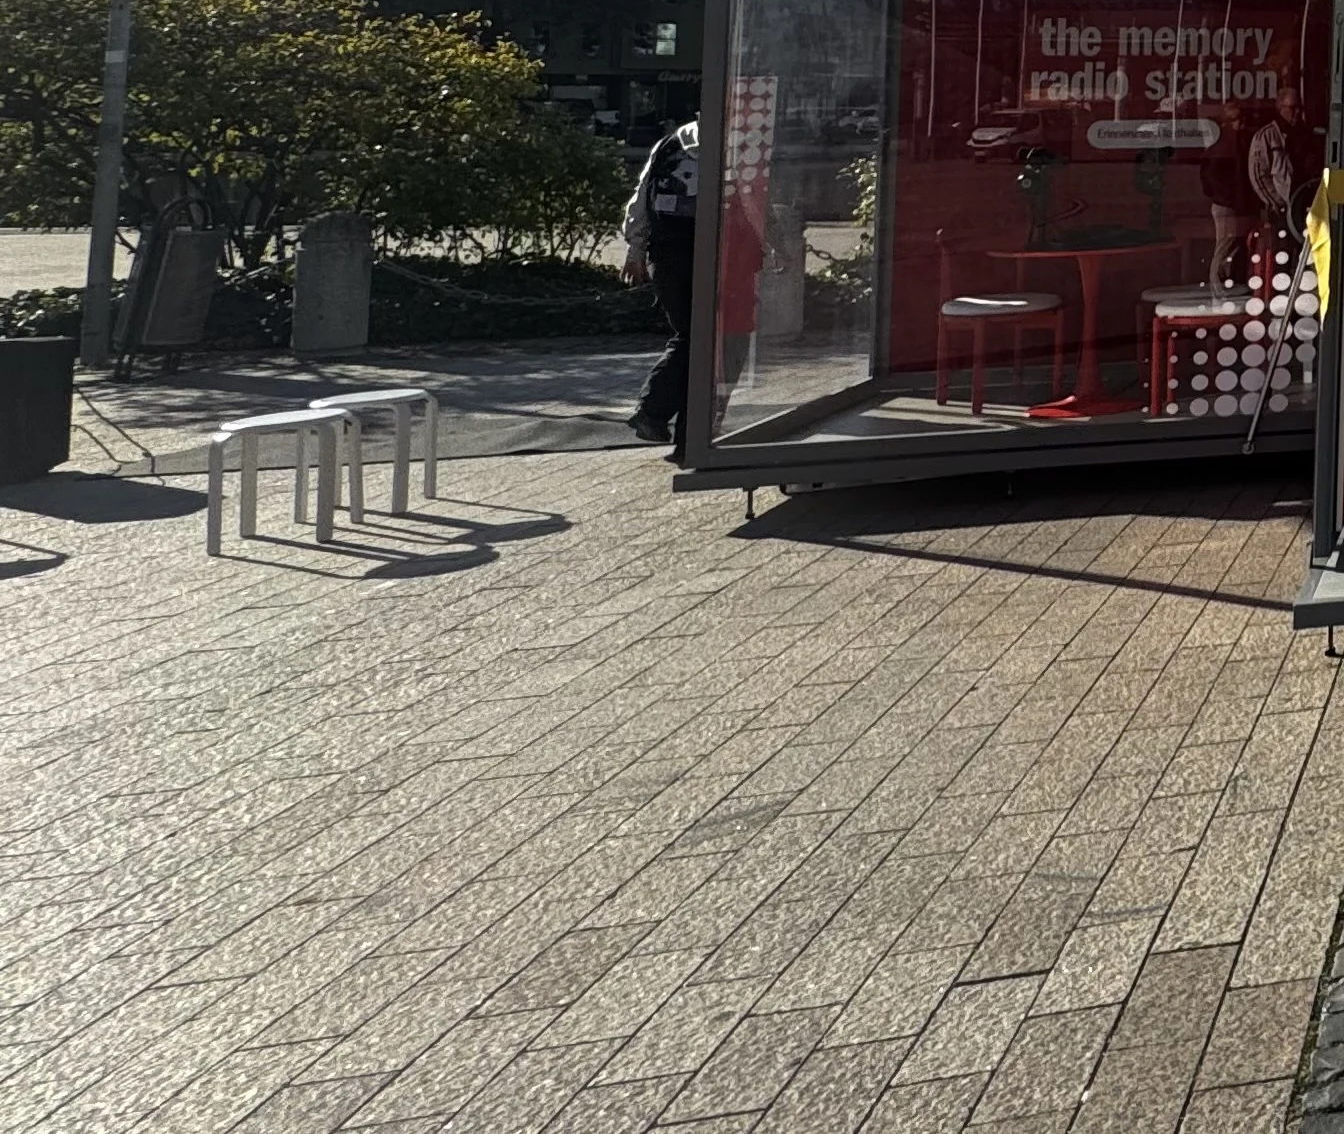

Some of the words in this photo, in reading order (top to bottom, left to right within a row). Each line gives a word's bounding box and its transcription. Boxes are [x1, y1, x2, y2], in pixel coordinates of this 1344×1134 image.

[1039, 17, 1103, 57] the
[1118, 25, 1274, 66] memory
[1030, 60, 1129, 101] radio
[1144, 60, 1278, 101] station
